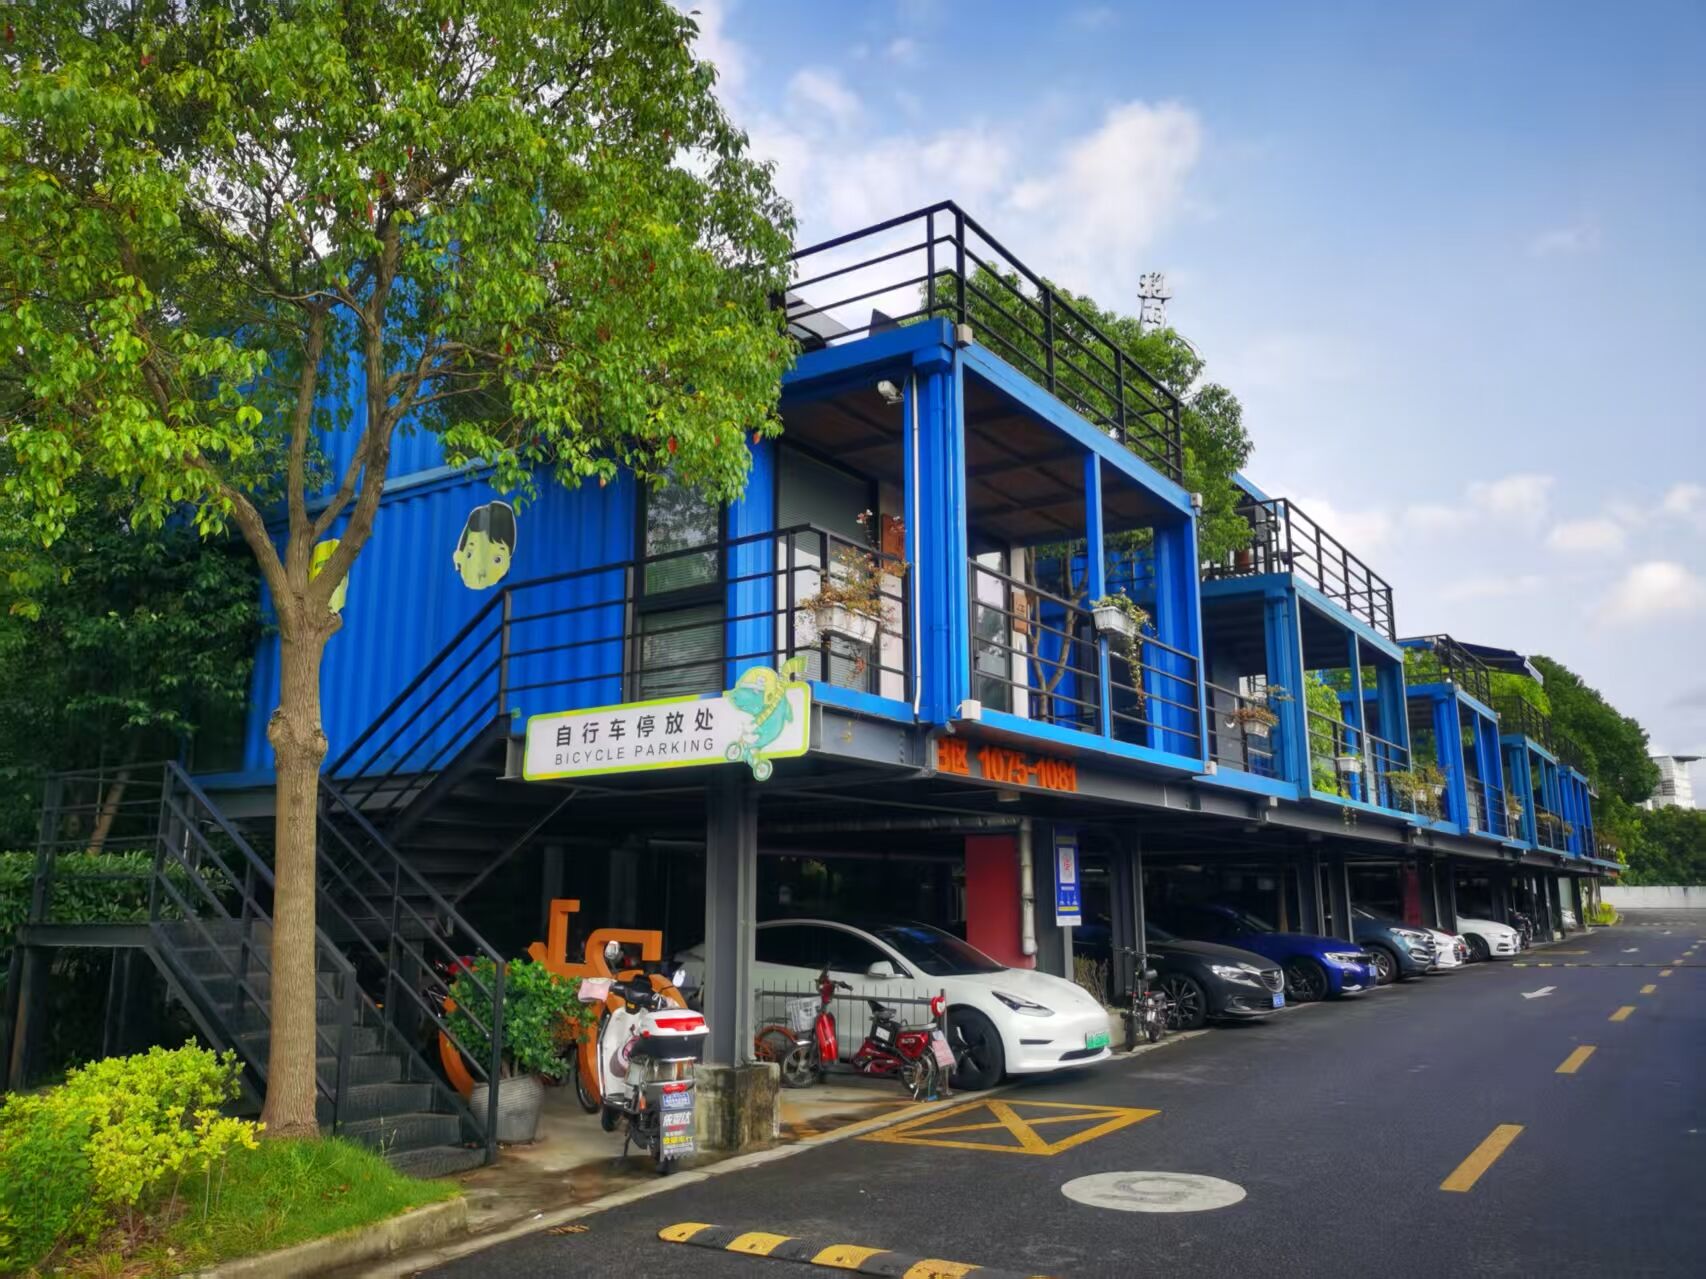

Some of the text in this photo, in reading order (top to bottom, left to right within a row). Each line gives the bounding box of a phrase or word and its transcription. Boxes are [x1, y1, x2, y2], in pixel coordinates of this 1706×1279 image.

[555, 708, 714, 748] 自行车停放处
[555, 737, 714, 766] BICYCLE PARKING
